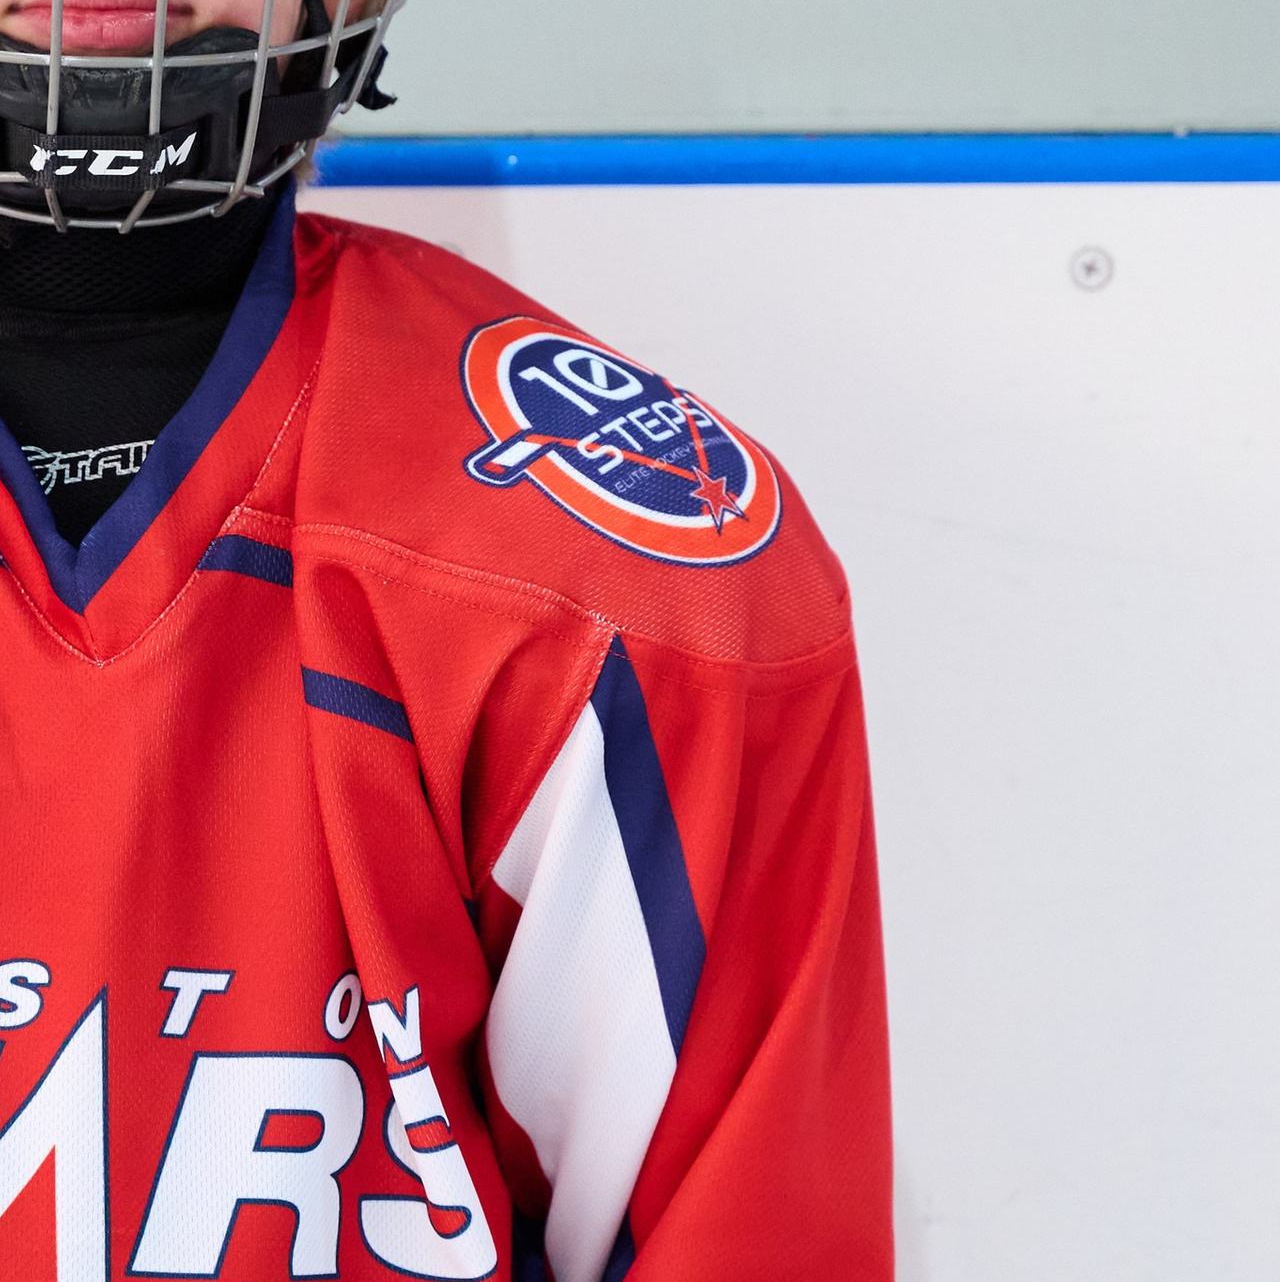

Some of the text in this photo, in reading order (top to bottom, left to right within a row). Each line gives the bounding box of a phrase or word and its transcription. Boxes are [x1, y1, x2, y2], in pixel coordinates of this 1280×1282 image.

[30, 131, 197, 176] CCM
[518, 348, 644, 417] 10
[576, 396, 713, 475] STEPS
[614, 465, 651, 494] ELITE
